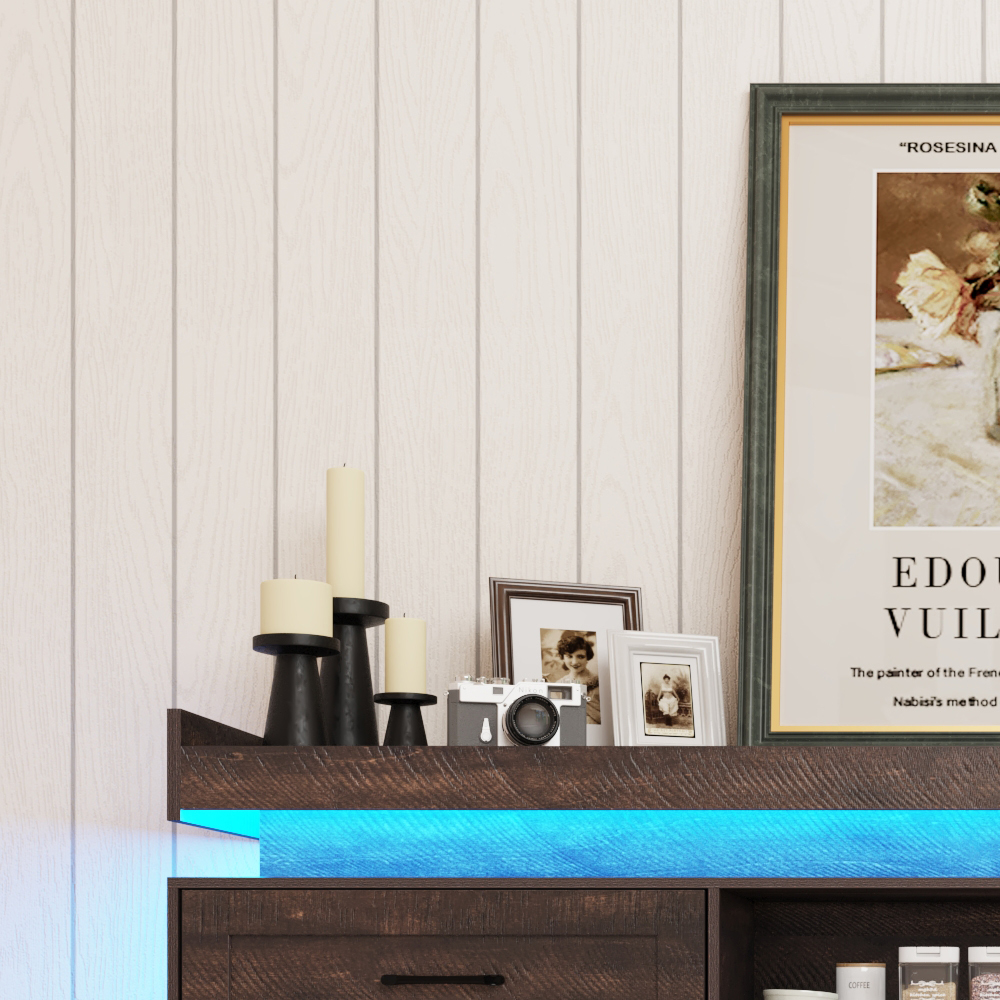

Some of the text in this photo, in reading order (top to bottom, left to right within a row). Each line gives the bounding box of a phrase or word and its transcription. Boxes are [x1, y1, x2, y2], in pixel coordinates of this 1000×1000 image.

[899, 141, 997, 154] “ROSESINA
[850, 667, 874, 678] The
[877, 667, 923, 681] painter
[927, 667, 940, 678] of
[942, 667, 965, 678] the
[946, 696, 997, 708] method
